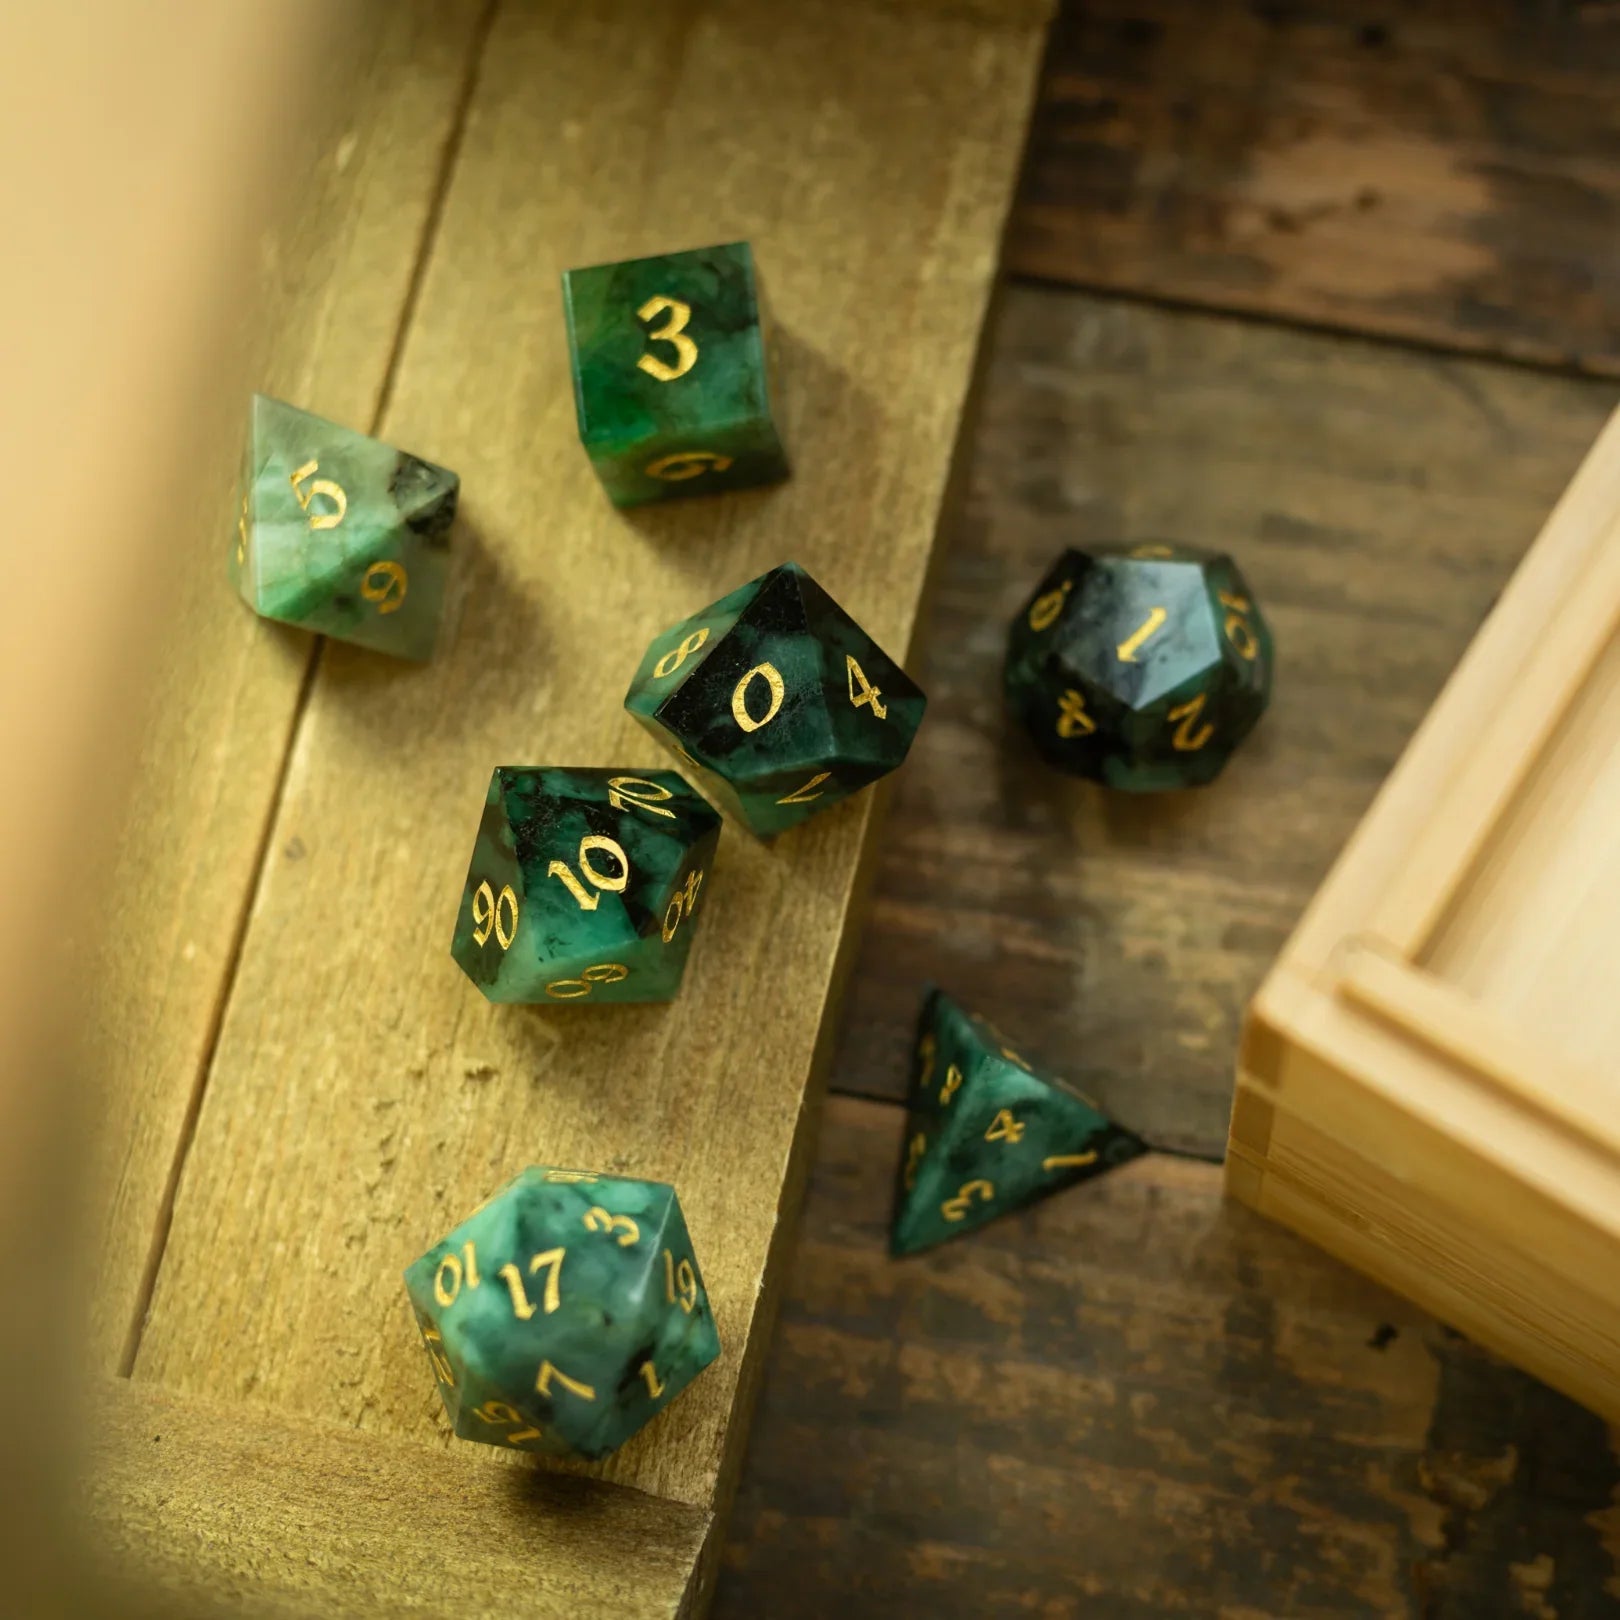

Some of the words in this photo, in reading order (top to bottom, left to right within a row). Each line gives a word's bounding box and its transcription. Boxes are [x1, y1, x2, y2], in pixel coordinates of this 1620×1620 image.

[637, 295, 698, 381] 3
[290, 459, 347, 529] 5
[653, 628, 710, 679] 8
[1116, 606, 1167, 663] 1
[731, 661, 785, 733] 0
[846, 654, 888, 720] 4
[1167, 693, 1215, 751] 2
[608, 776, 677, 819] 70
[548, 835, 629, 911] 10
[472, 880, 519, 950] 90
[984, 1109, 1025, 1143] 4
[1043, 1151, 1098, 1171] 1
[583, 1206, 640, 1247] 3
[941, 1179, 994, 1221] 3
[499, 1247, 566, 1320] 17
[663, 1248, 697, 1315] 19
[535, 1359, 596, 1401] 7
[640, 1360, 665, 1399] 1
